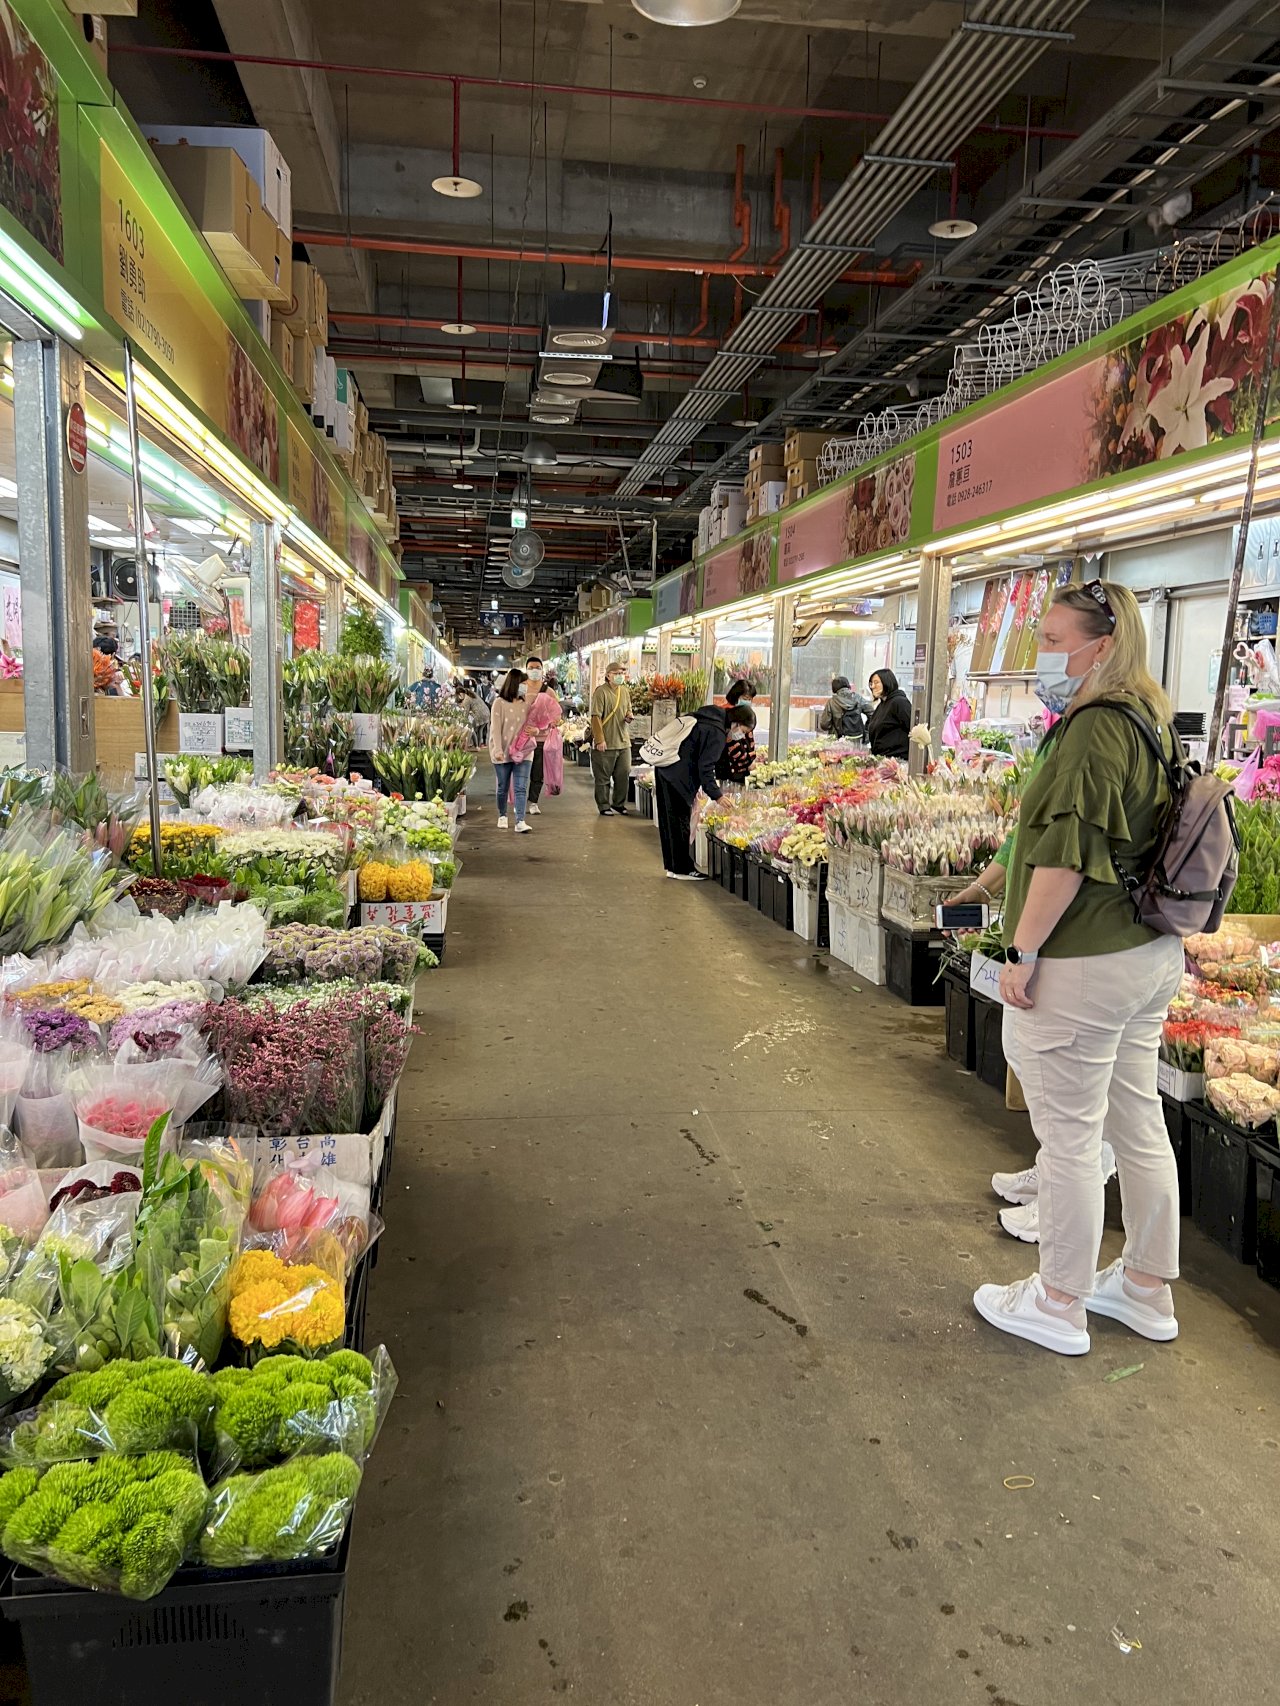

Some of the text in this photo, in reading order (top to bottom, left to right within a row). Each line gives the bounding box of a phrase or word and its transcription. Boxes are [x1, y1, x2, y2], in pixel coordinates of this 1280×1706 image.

[118, 198, 146, 260] 1603
[120, 288, 135, 324] 電話
[951, 439, 973, 465] 1503
